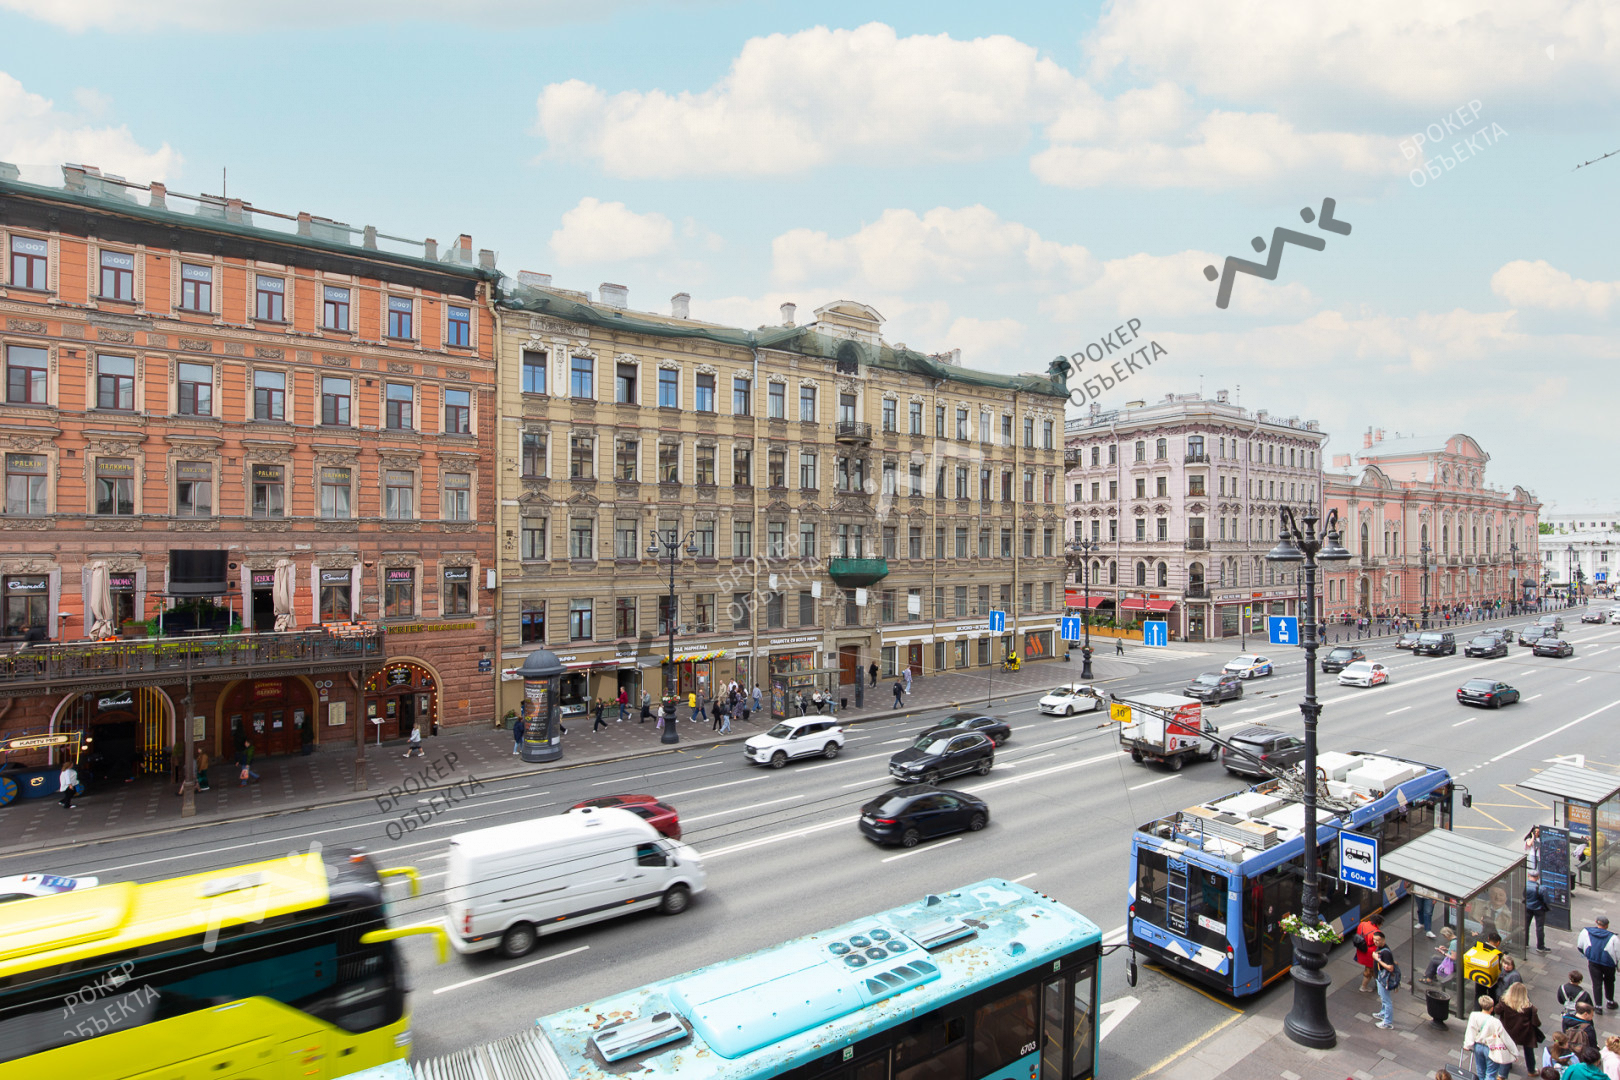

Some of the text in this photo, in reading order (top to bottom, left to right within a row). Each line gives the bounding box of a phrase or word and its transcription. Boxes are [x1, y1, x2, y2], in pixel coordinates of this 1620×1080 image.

[25, 242, 45, 252] 007
[113, 256, 131, 265] 007
[192, 269, 209, 278] 007
[266, 281, 281, 289] 007
[333, 291, 348, 299] 007
[397, 301, 410, 309] 007
[388, 623, 424, 634] KRIEK
[1116, 708, 1125, 717] 10
[1210, 874, 1216, 885] 5
[1350, 871, 1367, 882] 60м
[1020, 1040, 1037, 1056] 6703
